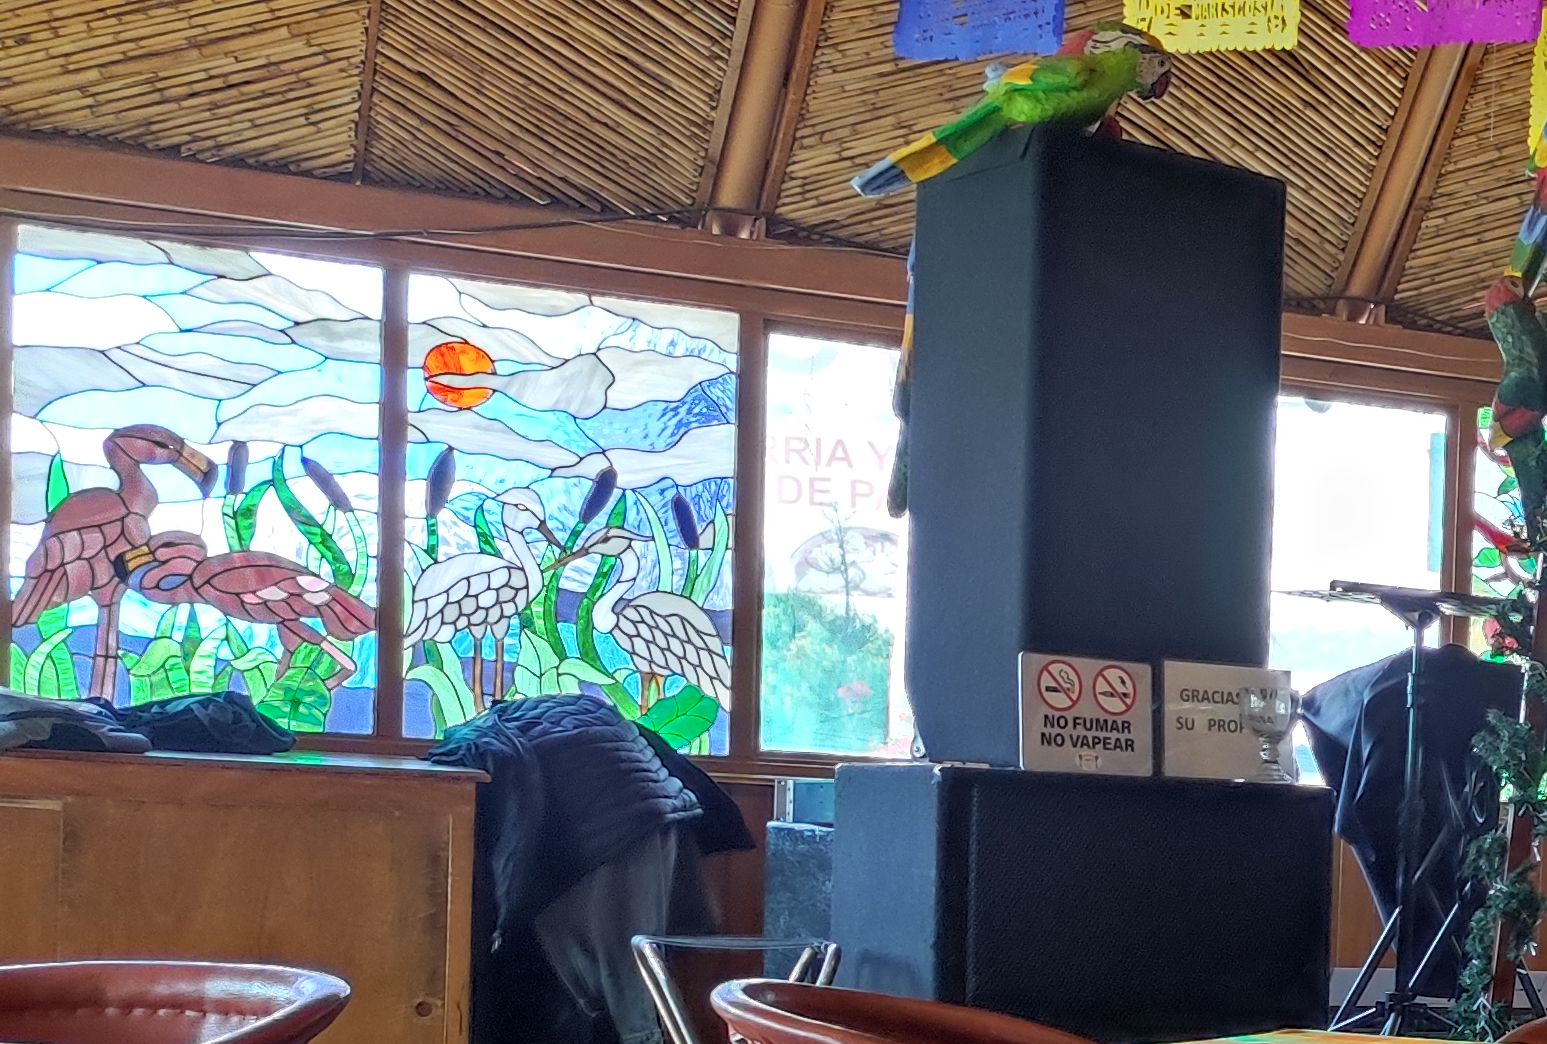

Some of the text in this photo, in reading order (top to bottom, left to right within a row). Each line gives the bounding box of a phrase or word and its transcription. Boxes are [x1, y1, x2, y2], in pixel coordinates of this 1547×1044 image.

[867, 440, 893, 472] Y
[777, 475, 834, 508] DE
[1043, 714, 1132, 735] NO FUMAR
[1176, 715, 1195, 731] SU
[1040, 732, 1135, 752] NO VAPEAR
